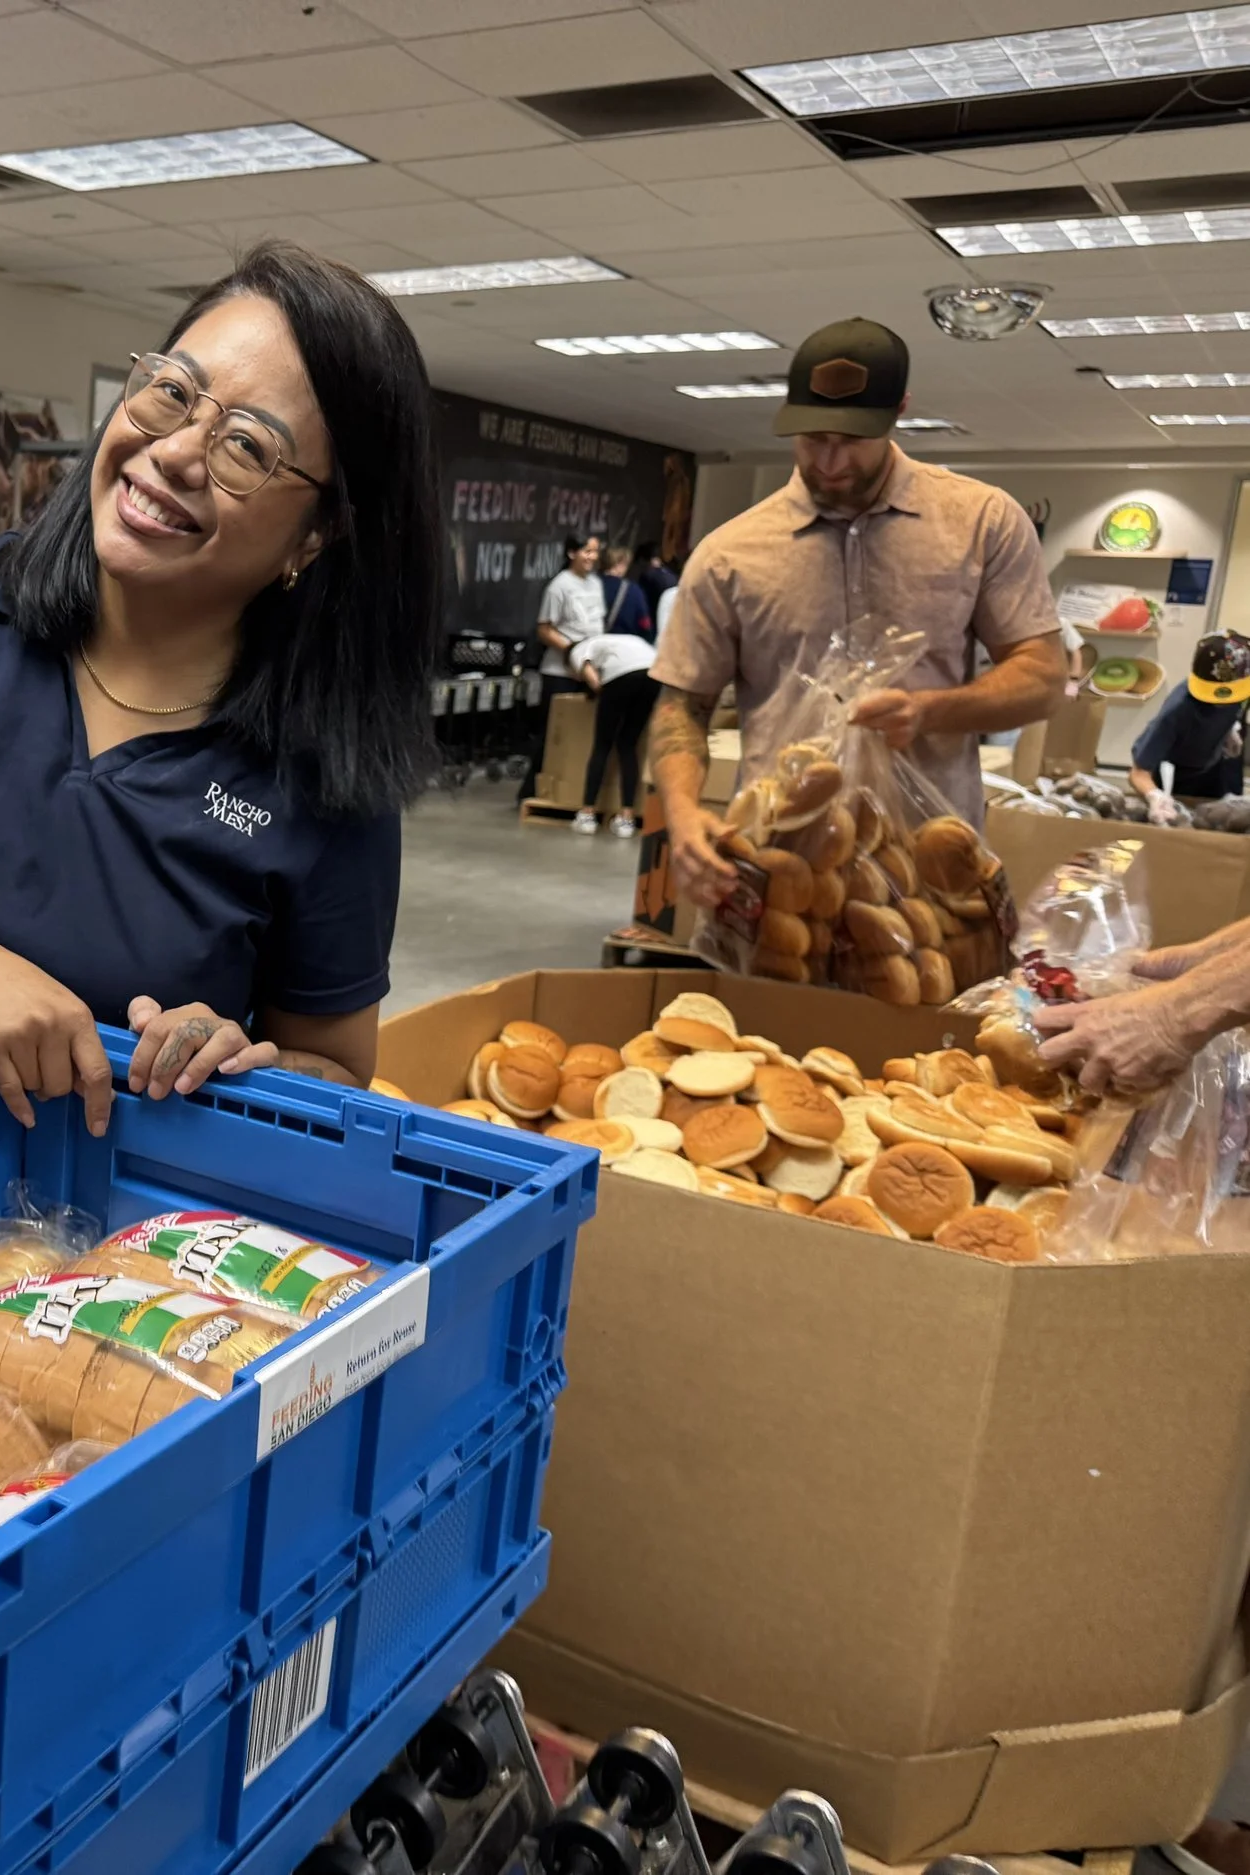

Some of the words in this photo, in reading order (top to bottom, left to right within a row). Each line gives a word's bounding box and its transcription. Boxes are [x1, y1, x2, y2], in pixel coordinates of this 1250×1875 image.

[452, 480, 536, 522] FEEDING
[547, 485, 610, 533] PEOPLE
[475, 541, 516, 582] NOT
[203, 801, 254, 838] MESA
[204, 781, 272, 826] RANCHO
[345, 1346, 377, 1377] Return
[378, 1336, 392, 1355] for
[393, 1320, 417, 1345] Reuse
[270, 1421, 295, 1450] SAN
[297, 1394, 332, 1429] DIEGO
[272, 1372, 333, 1431] FEEDING
